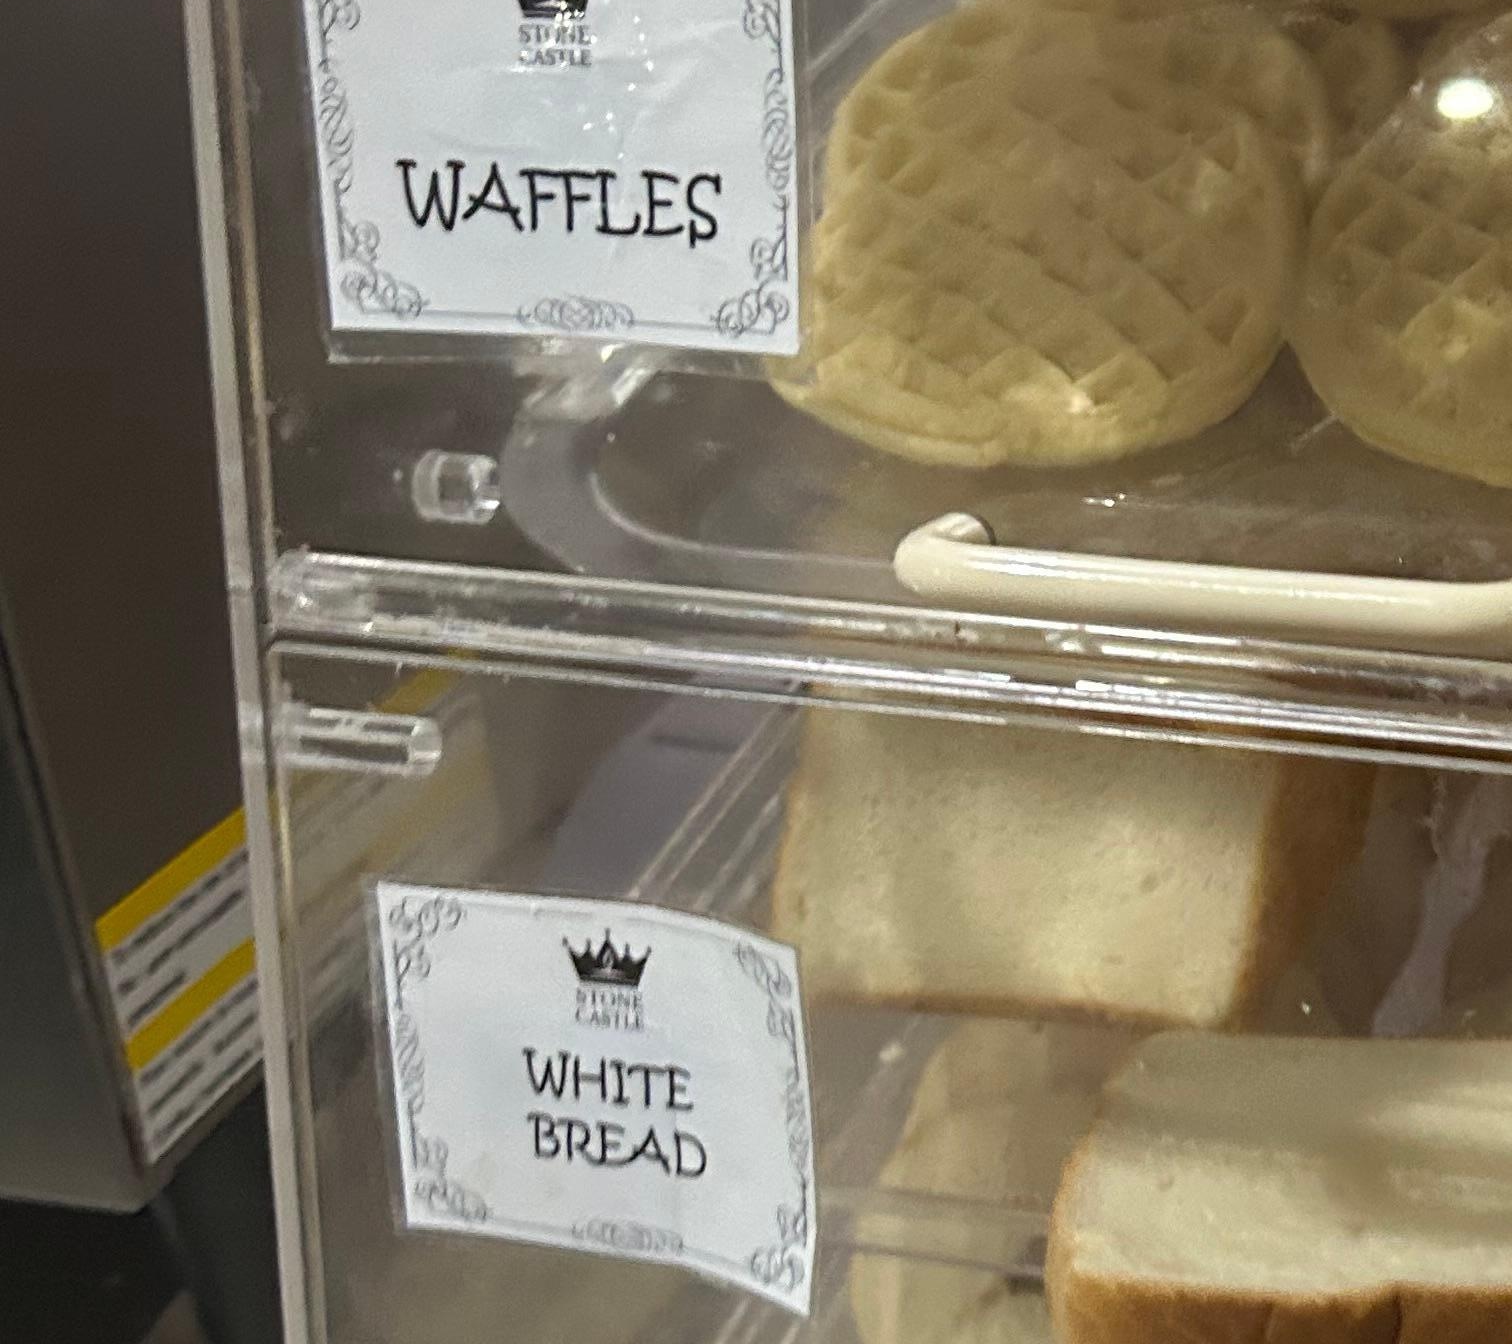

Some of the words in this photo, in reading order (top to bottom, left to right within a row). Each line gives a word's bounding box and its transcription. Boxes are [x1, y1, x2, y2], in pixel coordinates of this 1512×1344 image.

[396, 159, 722, 249] WAFFLES
[522, 1046, 694, 1111] WHITE
[526, 1111, 708, 1178] BREAD
